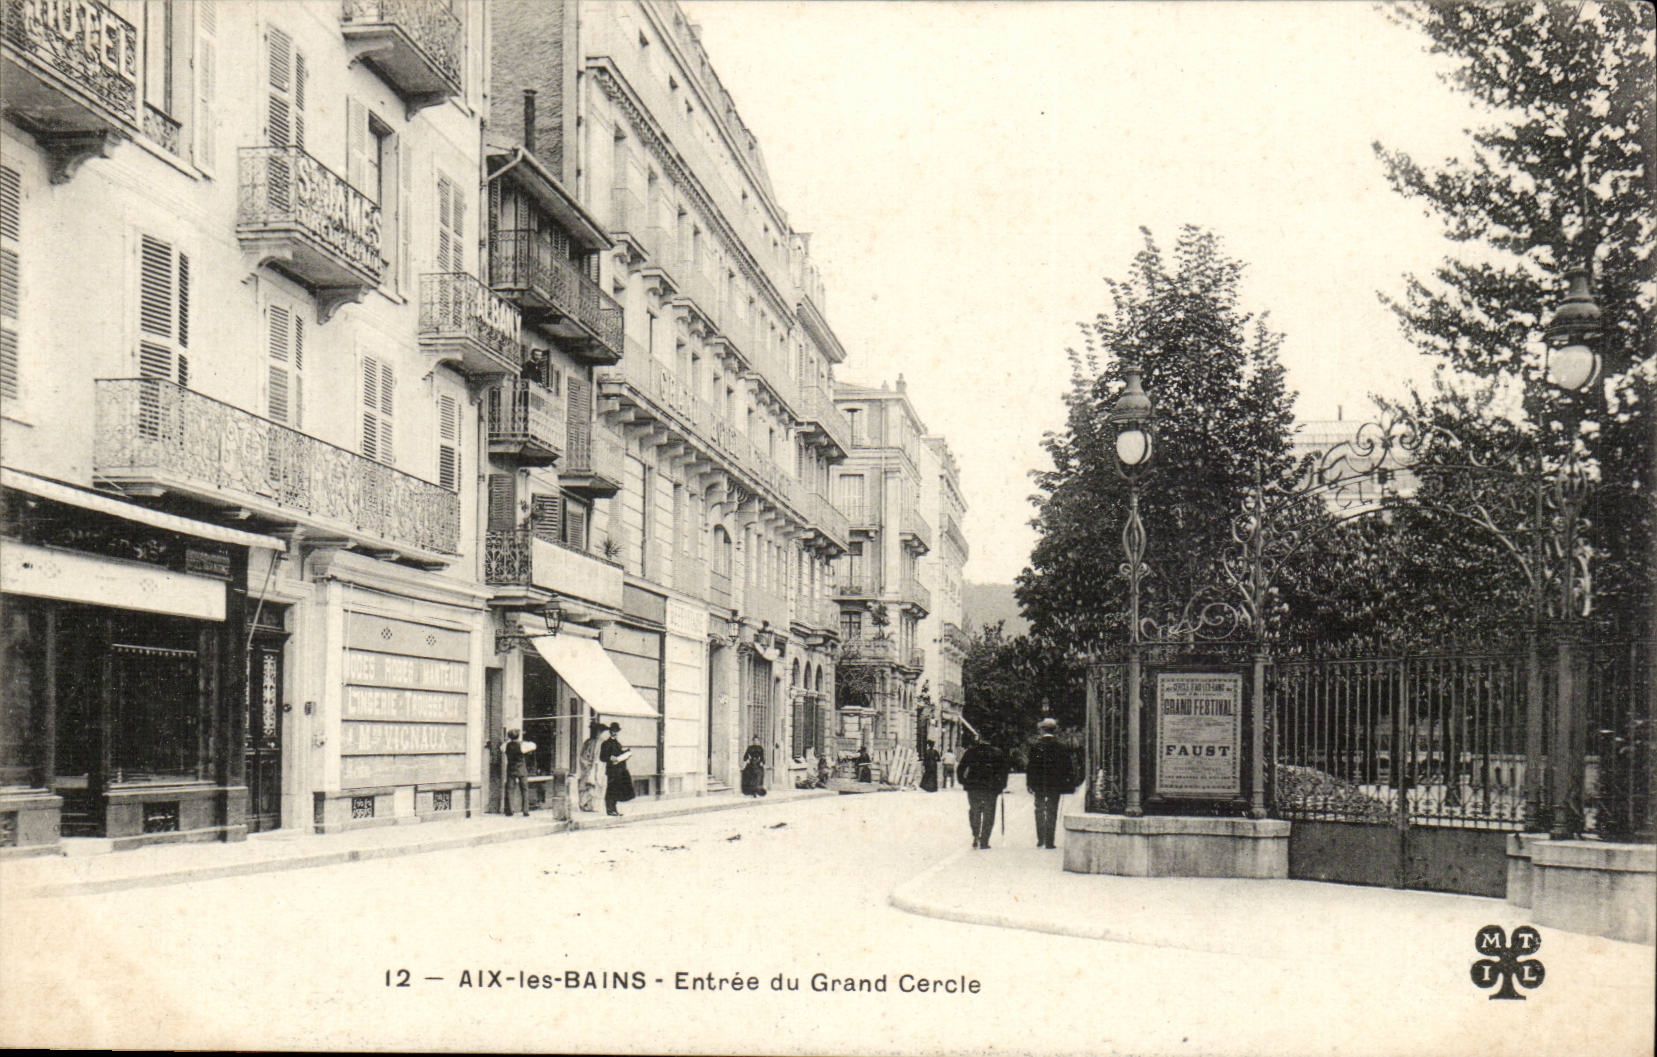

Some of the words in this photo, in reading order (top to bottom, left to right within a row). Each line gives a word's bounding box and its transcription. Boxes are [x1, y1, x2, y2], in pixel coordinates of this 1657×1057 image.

[1164, 699, 1192, 715] GRAND
[1194, 699, 1233, 716] FESTIVAL
[384, 725, 448, 751] VIGNAUX
[1165, 745, 1230, 756] FAUST
